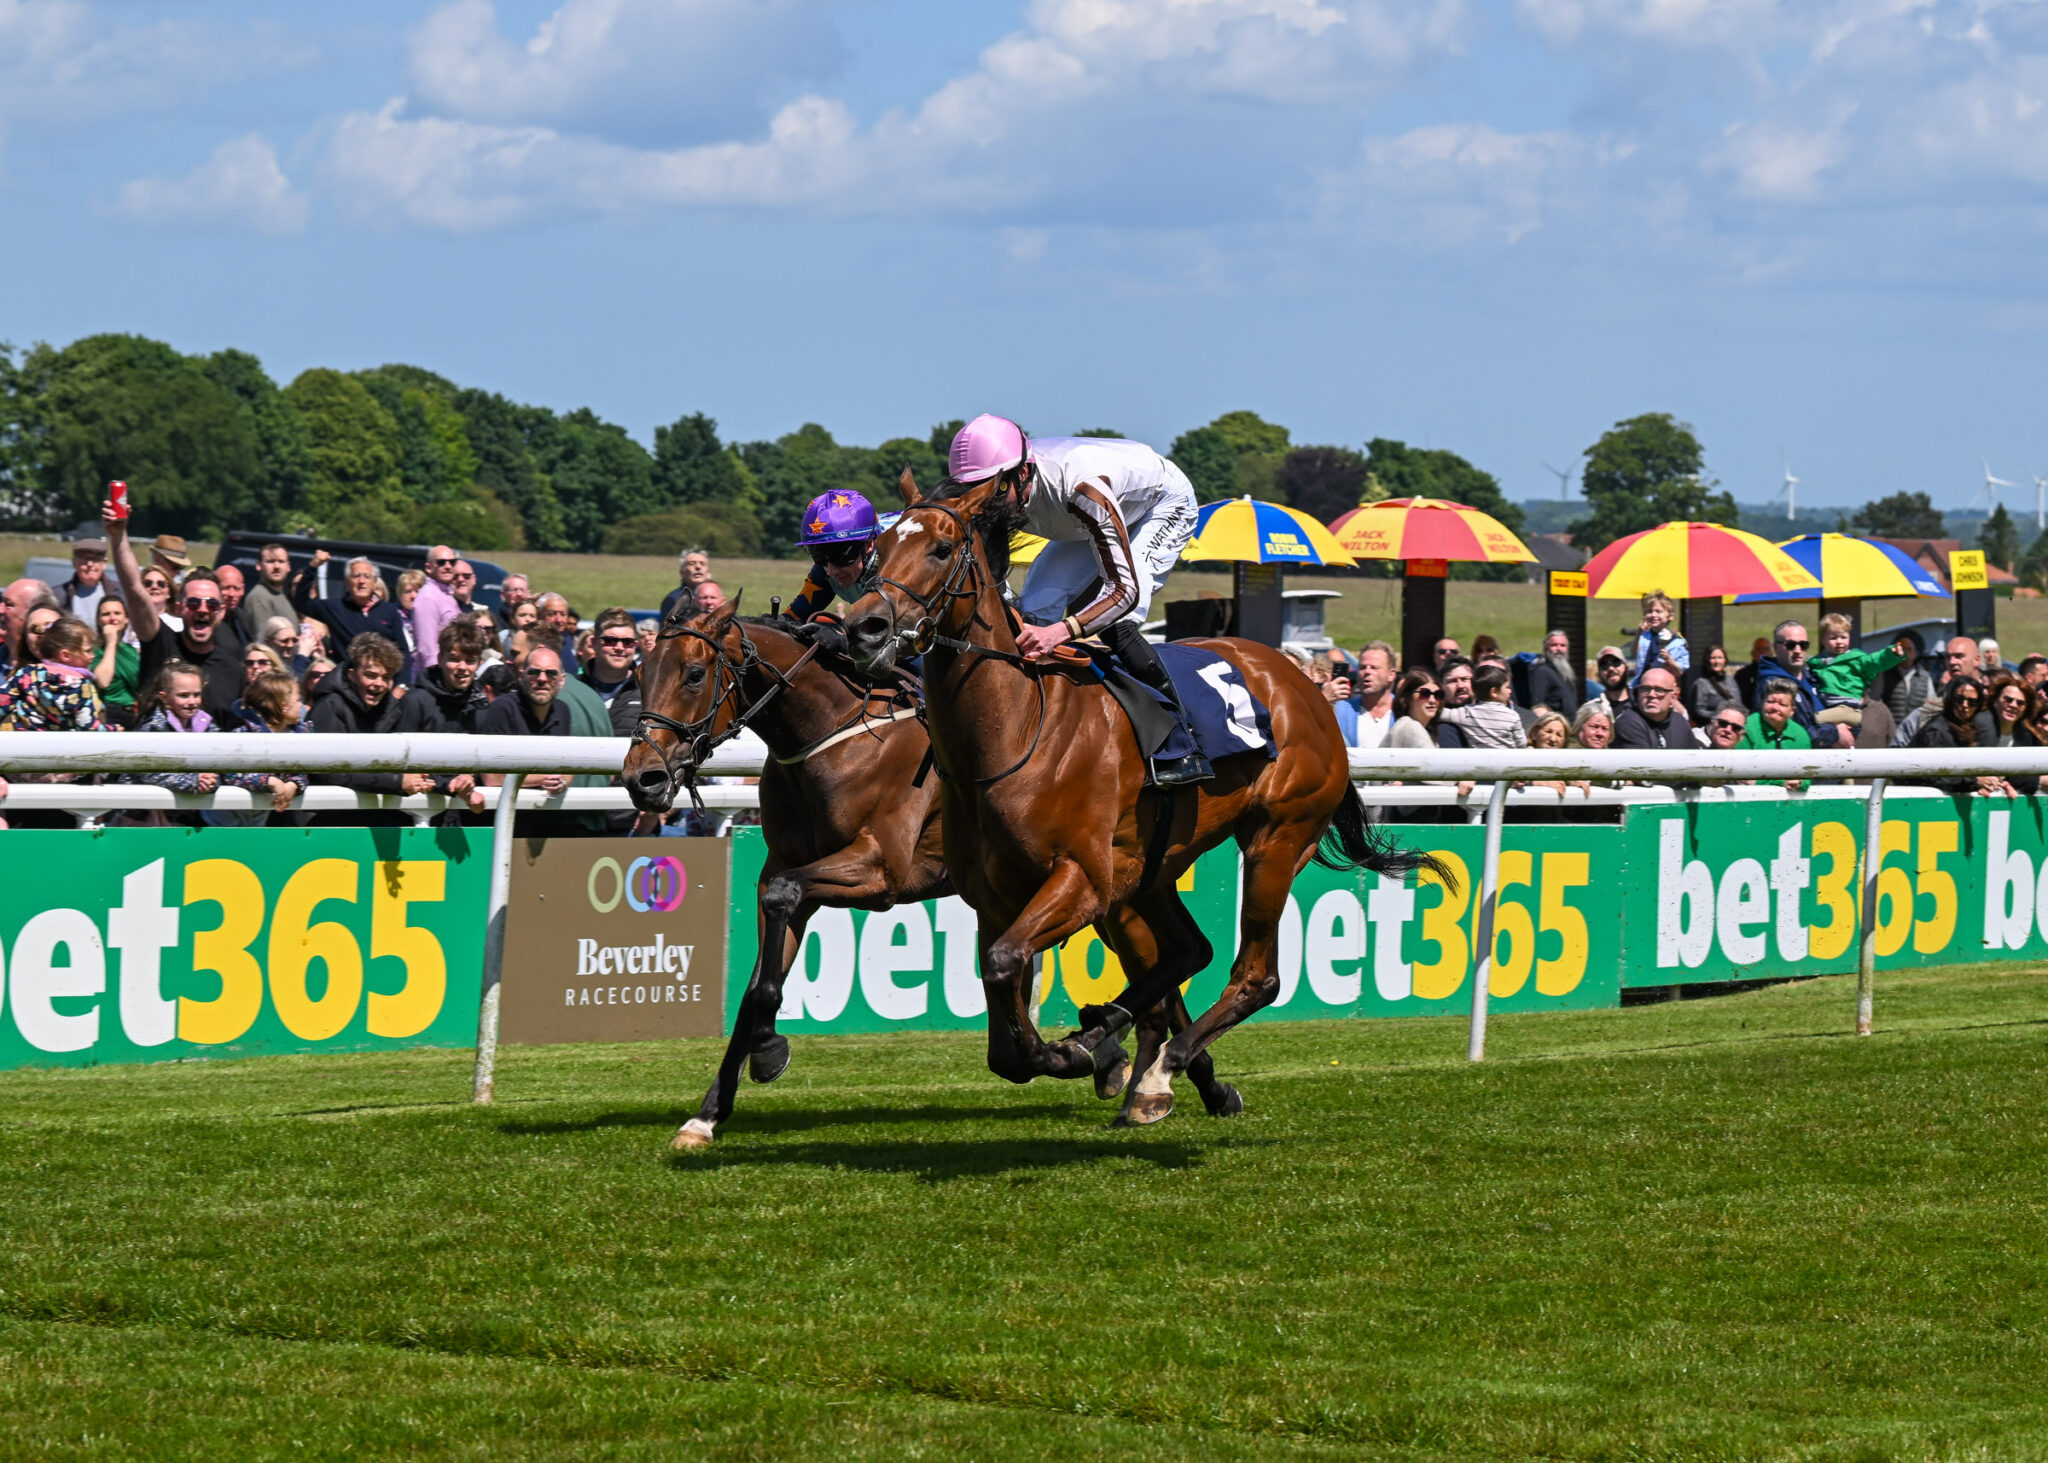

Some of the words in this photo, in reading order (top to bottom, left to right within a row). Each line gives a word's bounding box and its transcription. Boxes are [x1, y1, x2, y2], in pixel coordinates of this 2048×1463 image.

[1166, 517, 1190, 551] RACIN
[1352, 530, 1386, 539] JACK
[1954, 571, 1984, 583] JOHNSON
[1196, 661, 1267, 749] 5
[1656, 819, 1960, 968] bet365
[0, 857, 448, 1053] et365
[576, 933, 695, 981] Beverley
[565, 984, 702, 1006] RACECOURSE
